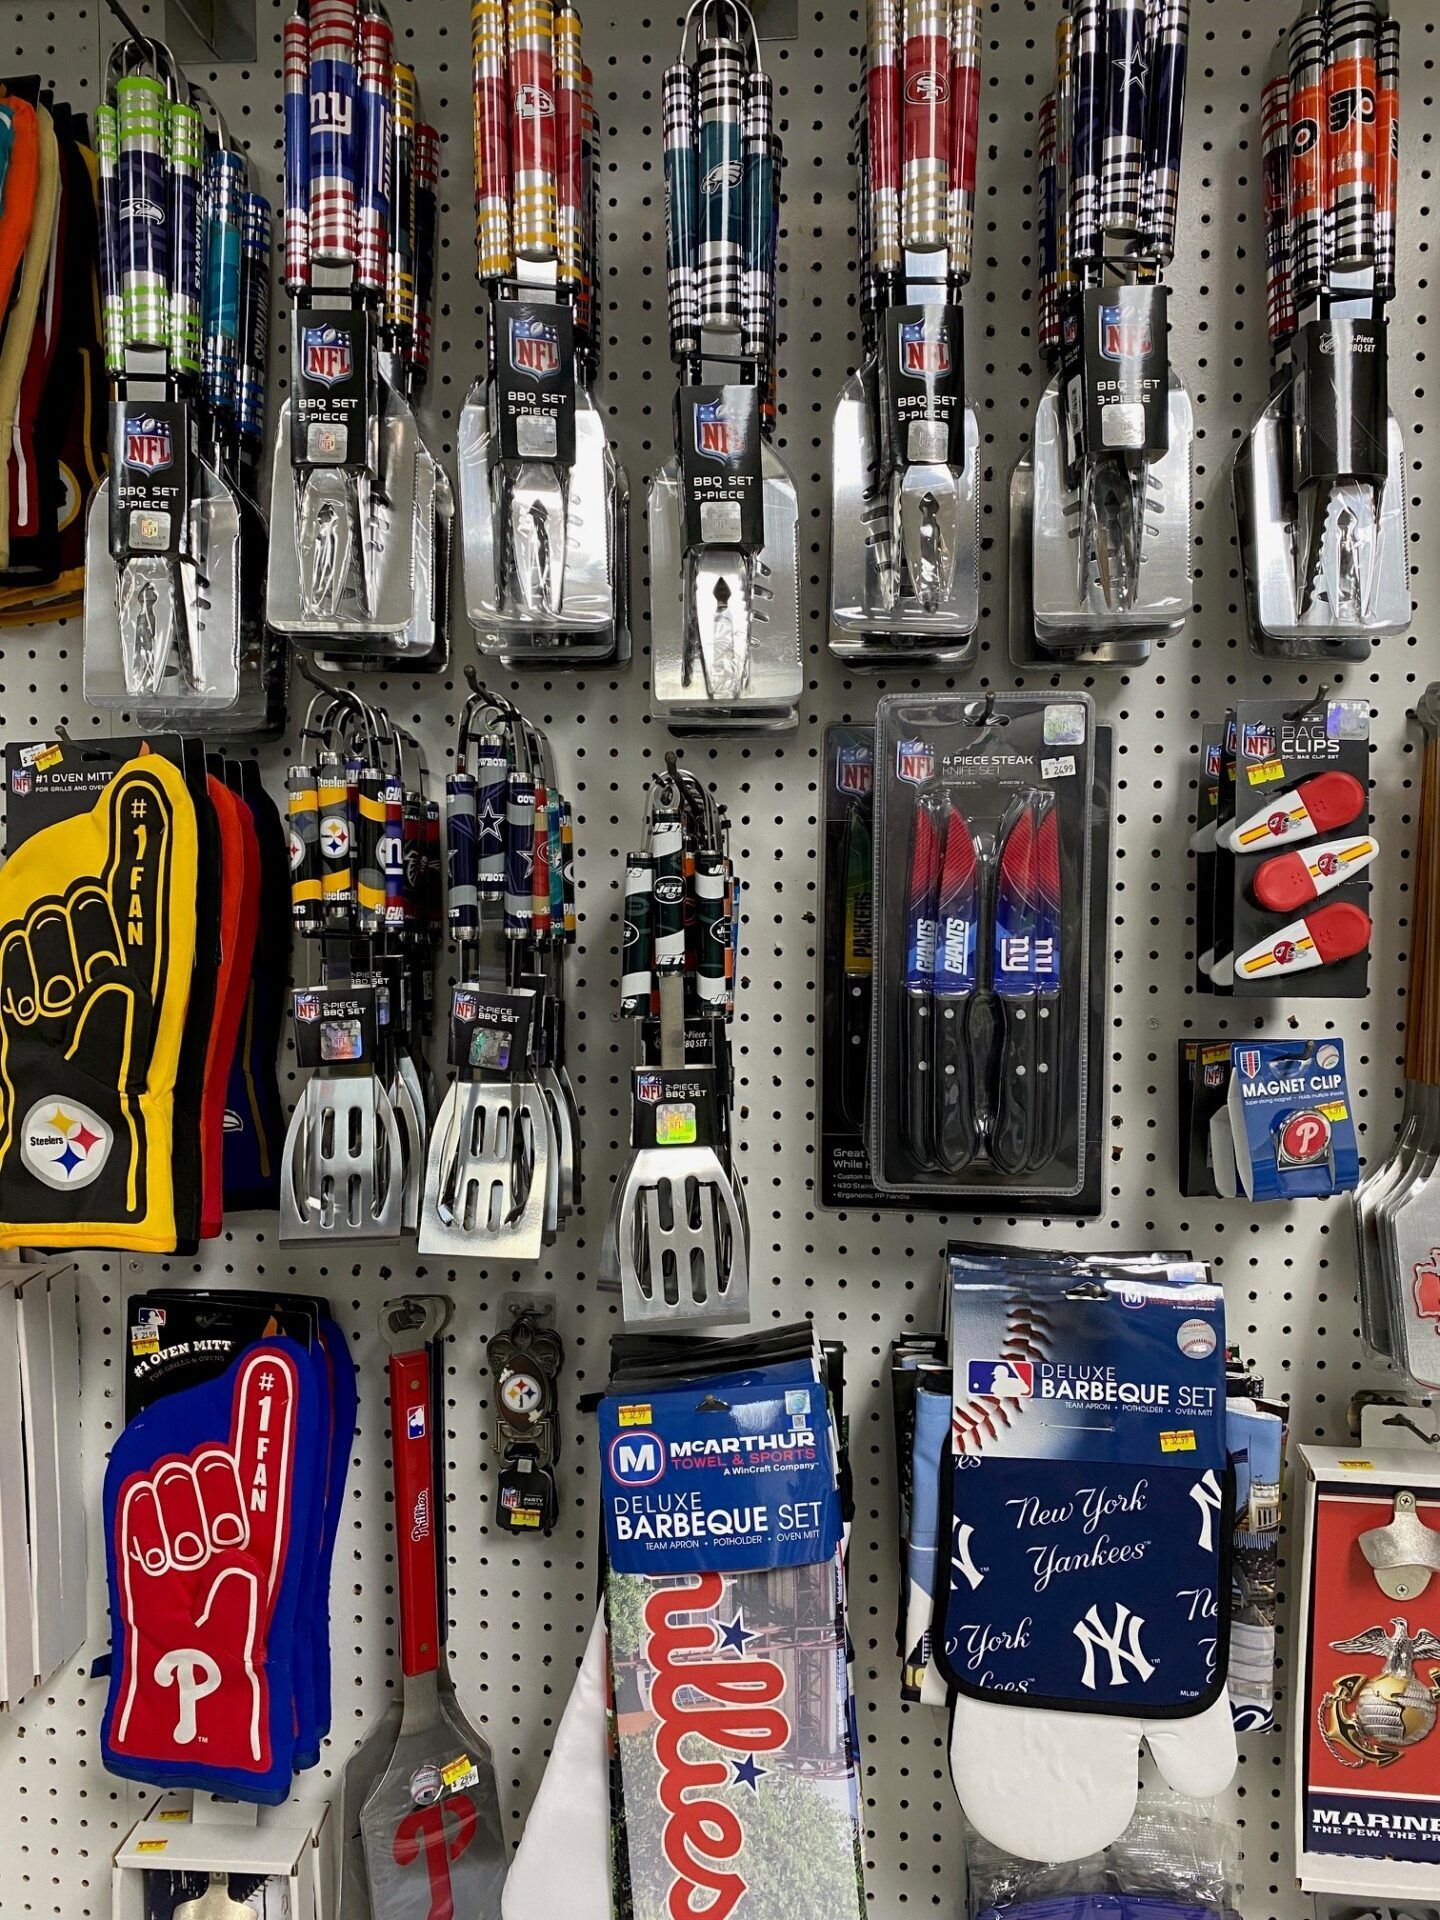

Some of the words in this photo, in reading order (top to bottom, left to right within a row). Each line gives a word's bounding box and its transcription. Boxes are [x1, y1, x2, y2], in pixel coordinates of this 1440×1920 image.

[309, 347, 351, 374] NFL
[516, 341, 560, 370] NFL
[1097, 381, 1127, 394] BBQ
[1134, 379, 1160, 389] SET
[298, 399, 327, 411] BBQ
[331, 398, 358, 409] SET
[508, 391, 536, 405] BBQ
[541, 393, 567, 404] SET
[898, 396, 927, 408] BBQ
[932, 395, 957, 406] SET
[1097, 394, 1151, 405] 3-PIECE
[298, 412, 348, 422] 3-PIECE
[508, 405, 559, 417] 3-PIECE
[898, 410, 949, 421] 3-PIECE
[129, 438, 171, 466] NFL
[693, 476, 723, 489] BBQ
[727, 476, 754, 487] SET
[118, 487, 147, 499] BBQ
[151, 487, 179, 497] SET
[694, 489, 745, 500] 3-PIECE
[117, 500, 170, 510] 3-PIECE
[1281, 725, 1325, 740] BAG
[1247, 736, 1275, 755] NFL
[1281, 739, 1340, 753] CLIPS
[902, 756, 934, 780] NFL
[942, 756, 952, 766] 4
[953, 755, 989, 765] PIECE
[991, 755, 1034, 765] STEAK
[35, 775, 48, 784] #1
[52, 773, 84, 783] OVEN
[87, 771, 114, 781] MITT
[843, 763, 873, 791] NF
[942, 766, 977, 776] KNIFE
[979, 765, 1000, 775] SET
[917, 917, 936, 973] GIANTS
[944, 917, 966, 974] GIANTS
[298, 1004, 320, 1019] NFL
[323, 1001, 359, 1010] 2-PIECE
[323, 1008, 345, 1019] BBQ
[347, 1007, 366, 1015] SET
[456, 1004, 476, 1020] NFL
[478, 1005, 513, 1016] 2-PIECE
[478, 1012, 498, 1023] BBQ
[501, 1014, 520, 1023] SET
[641, 1084, 662, 1099] NFL
[665, 1083, 700, 1091] 2-PIECE
[1242, 1078, 1306, 1098] MAGNET
[1310, 1074, 1342, 1091] CLIP
[665, 1090, 686, 1100] BBQ
[688, 1089, 708, 1097] SET
[30, 1134, 64, 1148] Steelers
[833, 1148, 866, 1158] Great
[833, 1159, 863, 1169] While
[133, 1360, 152, 1378] #1
[149, 1342, 191, 1365] OVEN
[192, 1340, 232, 1352] MITT
[1041, 1363, 1116, 1381] DELUXE
[1041, 1378, 1170, 1405] BARBEQUE
[1178, 1385, 1217, 1408] SET
[1064, 1401, 1084, 1410] TEAM
[1085, 1402, 1111, 1411] APRON
[1122, 1405, 1164, 1414] POTHOLDER
[1174, 1407, 1196, 1416] OVEN
[1197, 1408, 1213, 1416] MITT
[618, 1444, 655, 1473] M
[671, 1456, 728, 1471] TOWEL
[732, 1454, 744, 1466] &
[749, 1449, 816, 1464] SPORTS
[250, 1437, 270, 1512] FAN
[723, 1467, 731, 1476] A
[732, 1464, 772, 1475] WinCraft
[614, 1491, 702, 1515] DELUXE
[1005, 1495, 1073, 1529] New
[1074, 1478, 1148, 1535] York
[411, 1487, 429, 1542] Phillies
[615, 1505, 769, 1541] BARBEQUE
[778, 1501, 823, 1530] SET
[645, 1542, 668, 1551] TEAM
[669, 1539, 700, 1550] APRON
[713, 1535, 764, 1547] POTHOLDER
[776, 1532, 802, 1542] OVEN
[802, 1529, 821, 1540] MITT
[1312, 1825, 1342, 1835] THE
[1347, 1828, 1383, 1838] FEW.
[1387, 1831, 1417, 1840] THE
